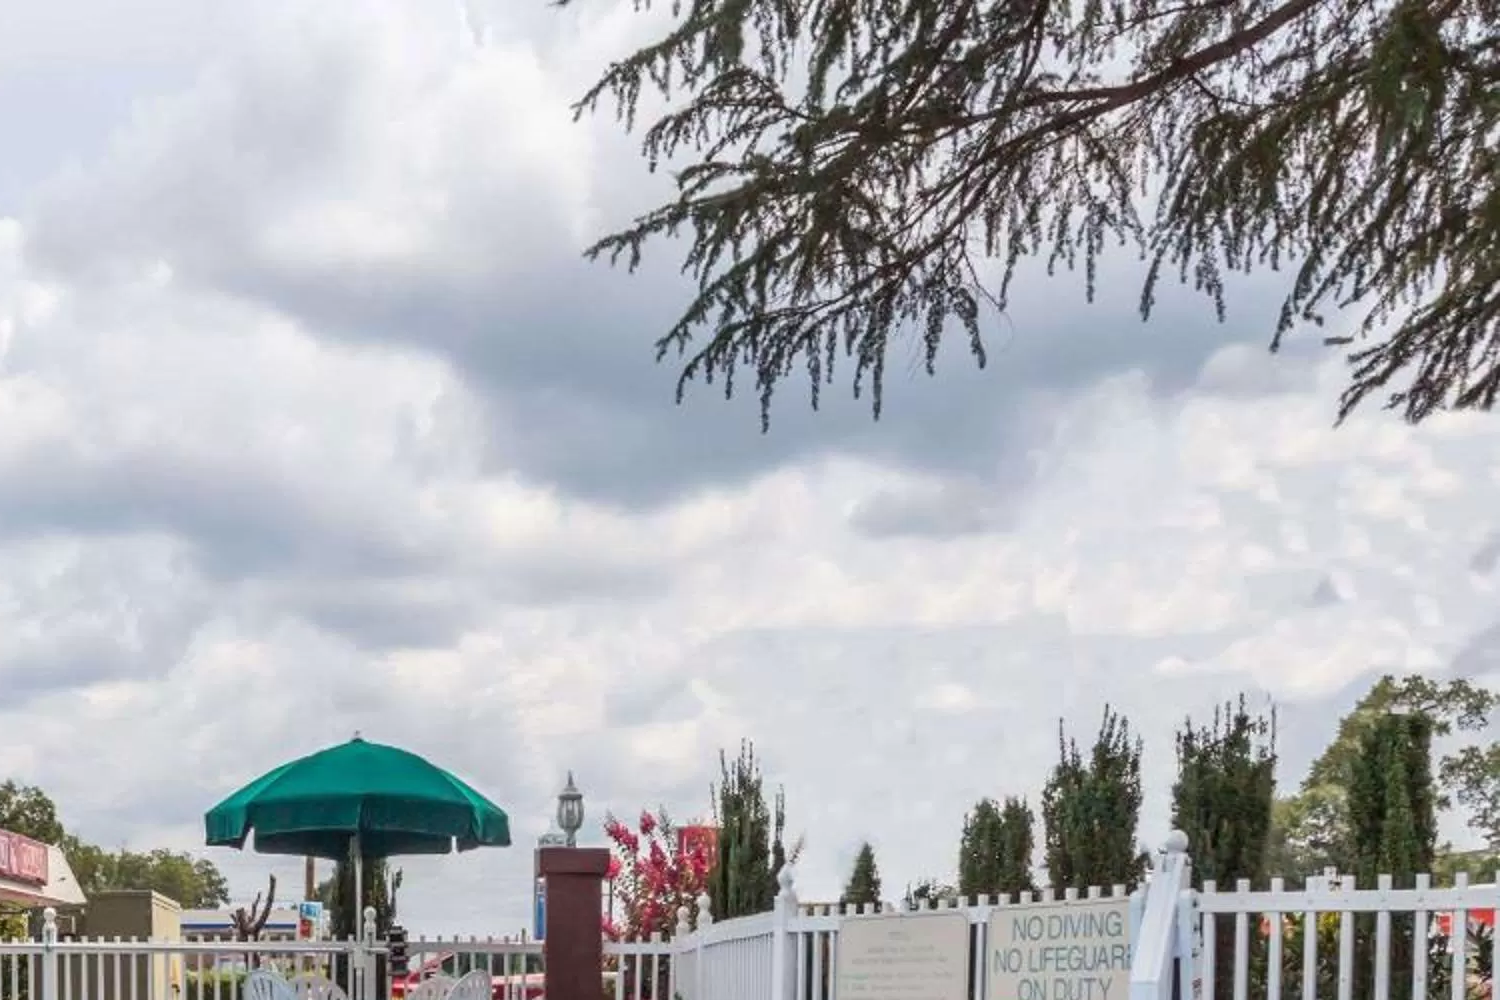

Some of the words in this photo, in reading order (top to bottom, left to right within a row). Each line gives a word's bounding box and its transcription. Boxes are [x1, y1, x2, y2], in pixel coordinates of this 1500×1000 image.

[1012, 915, 1044, 941] NO
[1047, 911, 1124, 940] DIVING
[994, 947, 1023, 974] NO
